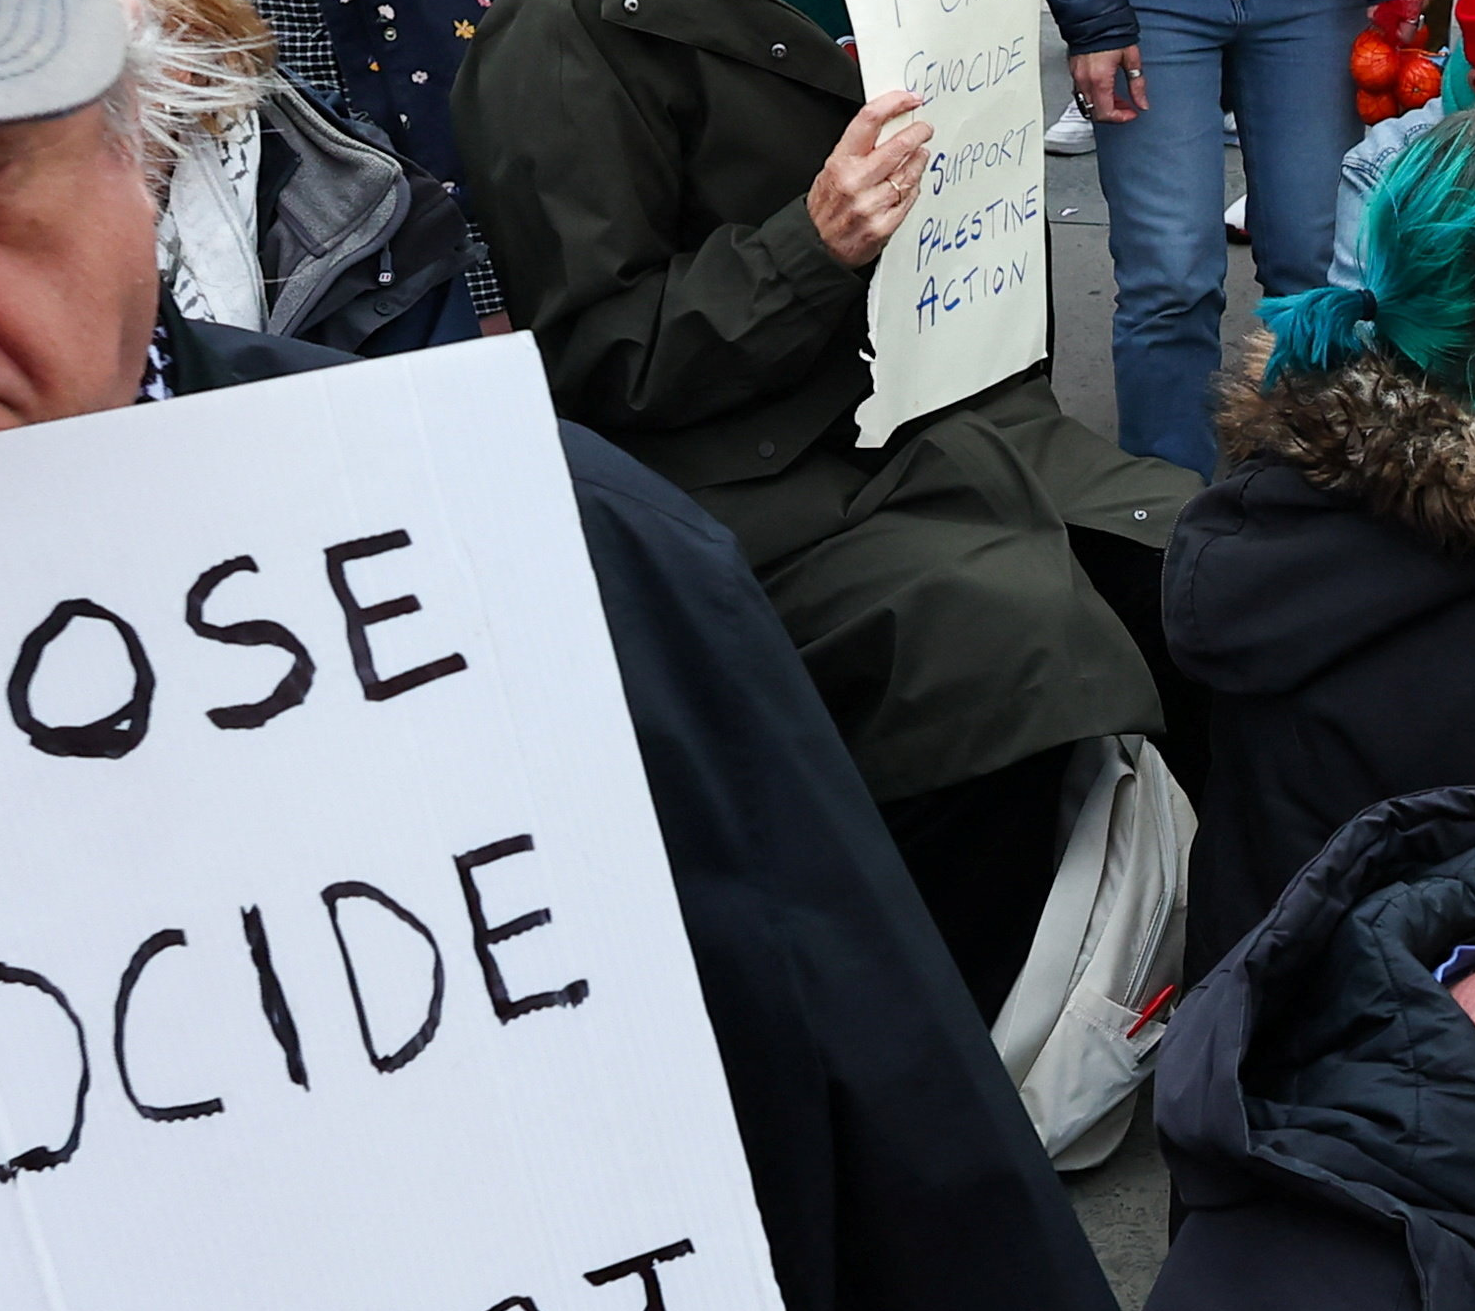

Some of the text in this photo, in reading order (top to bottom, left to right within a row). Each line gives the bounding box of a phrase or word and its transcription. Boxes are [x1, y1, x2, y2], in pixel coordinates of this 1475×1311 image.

[904, 36, 1026, 107] GENOCIDE
[929, 119, 1036, 196] SUPPORT
[916, 184, 1038, 273] PALESTINE
[916, 251, 1028, 335] ACTION
